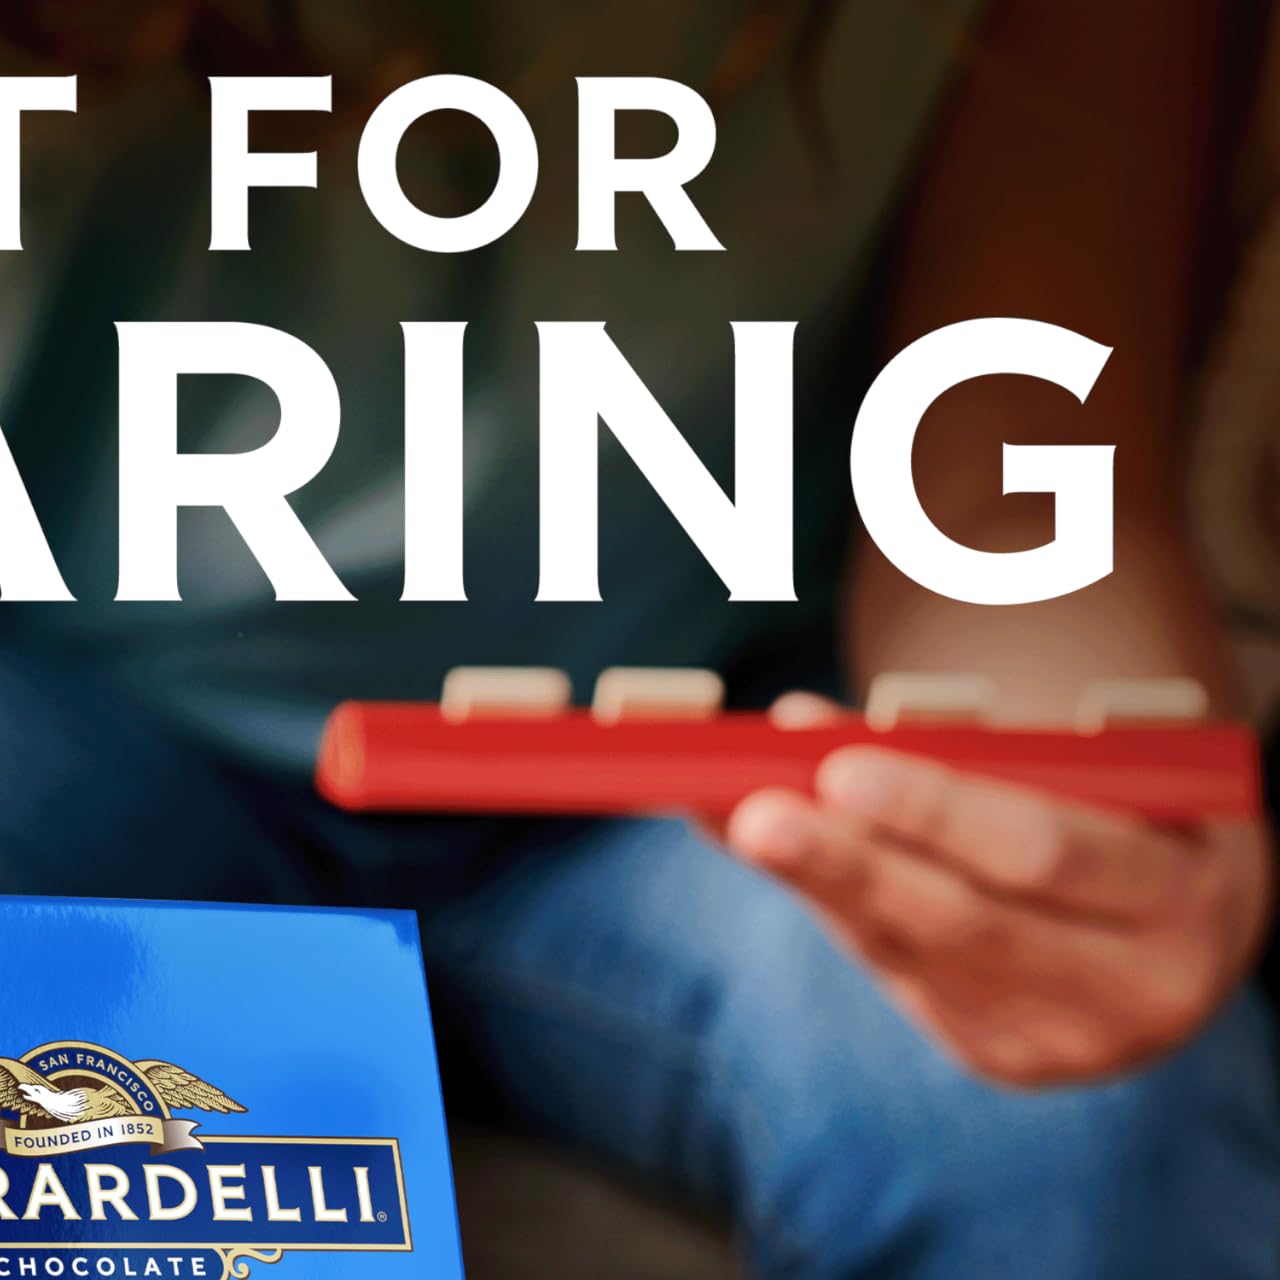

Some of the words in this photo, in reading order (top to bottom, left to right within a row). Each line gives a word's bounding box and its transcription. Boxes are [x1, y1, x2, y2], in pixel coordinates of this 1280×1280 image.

[38, 1053, 69, 1071] SAN
[76, 1054, 154, 1111] FRANCISCO
[14, 1130, 91, 1149] FOUNDED
[97, 1126, 114, 1138] IN
[121, 1123, 154, 1136] 1852
